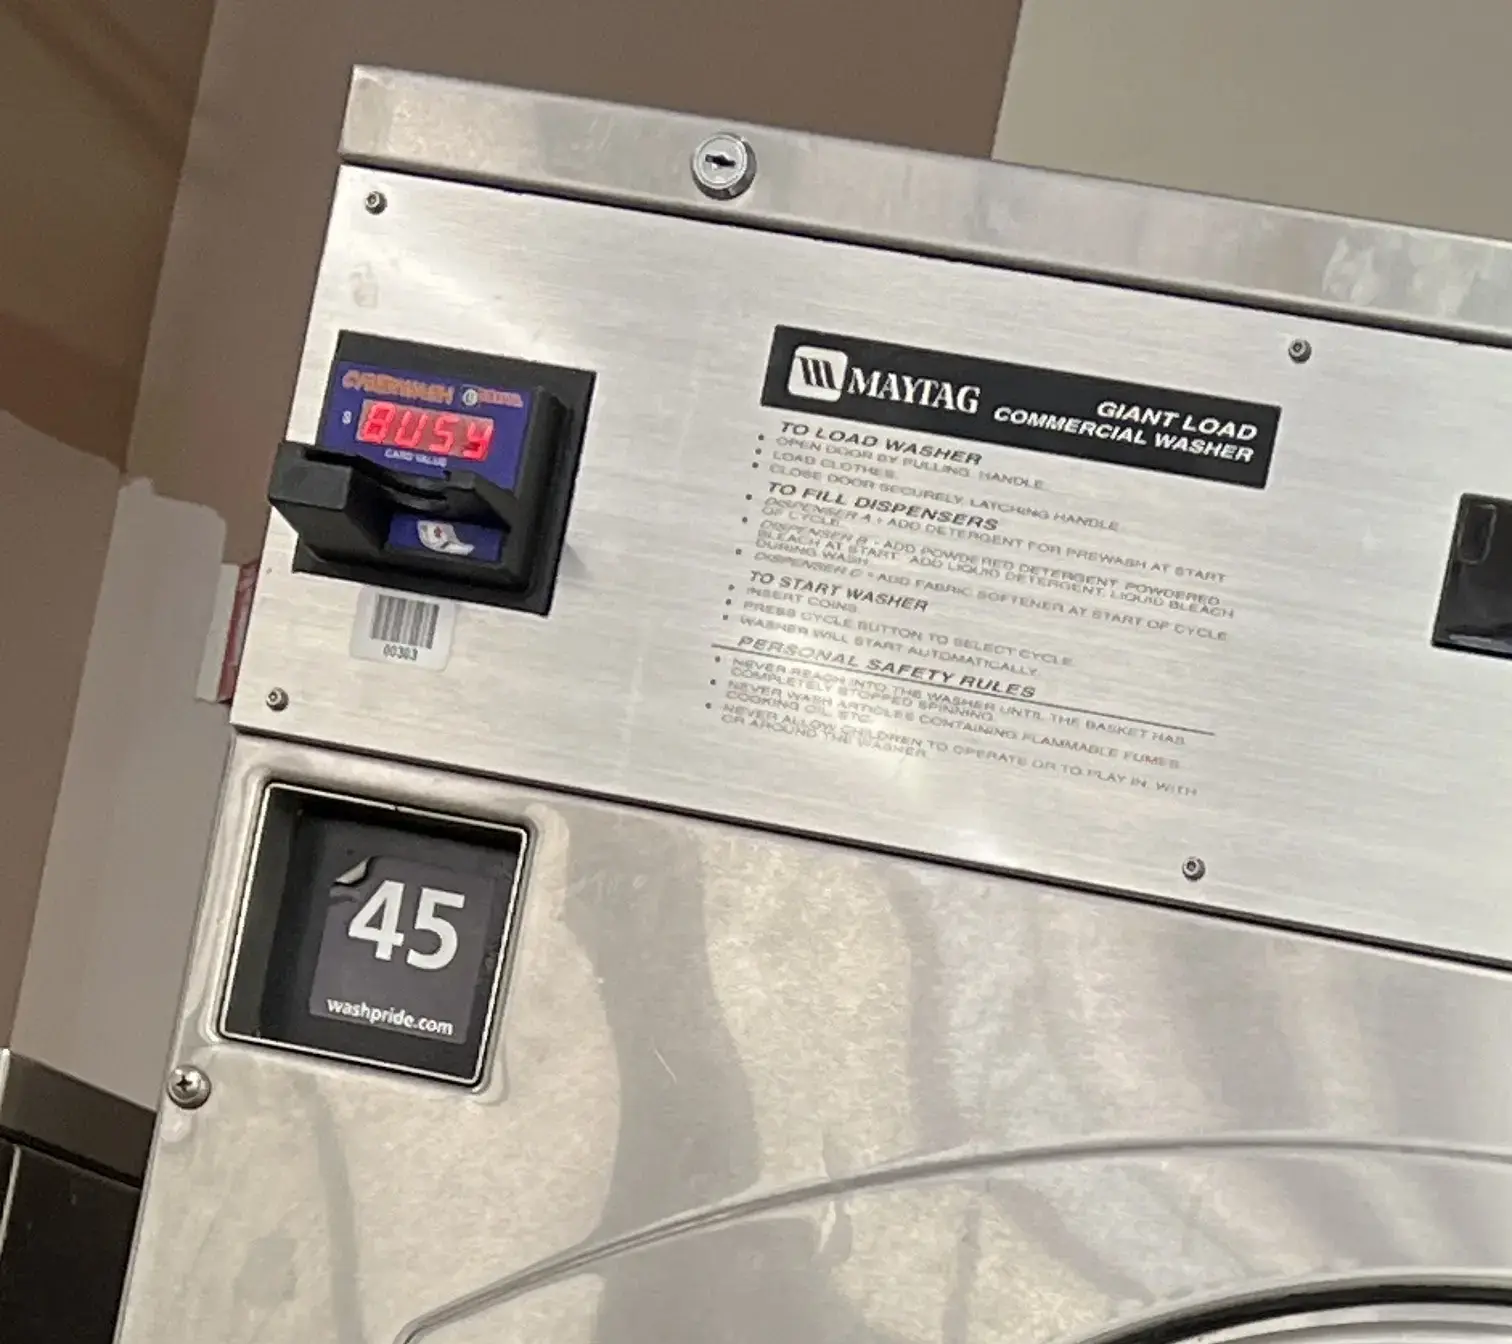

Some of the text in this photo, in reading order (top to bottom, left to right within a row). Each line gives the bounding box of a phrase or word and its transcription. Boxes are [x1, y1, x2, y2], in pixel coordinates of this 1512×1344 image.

[847, 366, 981, 415] MAYTAG
[994, 406, 1254, 465] COMMERCIAL WASHER
[1097, 401, 1258, 441] GIANT LOAD
[415, 451, 447, 467] VALUE
[772, 450, 816, 466] LOAD
[775, 435, 821, 450] OPEN
[825, 443, 873, 460] DOOR
[780, 420, 982, 467] TO LOAD WASHER
[768, 463, 821, 480] CLOSE
[826, 473, 874, 490] DOOR
[768, 481, 998, 531] TO FILL DISPENSERS
[882, 540, 916, 554] ADD
[886, 517, 921, 531] ADD
[924, 524, 1023, 549] DETERGENT
[1027, 541, 1060, 555] FOR
[1150, 563, 1170, 574] AT
[1174, 567, 1226, 584] START
[750, 569, 928, 612] TO START WASHER
[876, 572, 1170, 631] ADD FABRIC SOFTENER AT START OF
[1168, 600, 1234, 619] BLEACH
[740, 616, 808, 637] WASHER
[853, 636, 902, 654] START
[742, 600, 1017, 657] PRESS CYCLE BUTTON TO SELECT
[736, 634, 1036, 698] PERSONAL SAFETY RULES
[952, 744, 1028, 766] OPERATE
[1030, 757, 1056, 771] OR
[1060, 762, 1080, 775] TO
[1086, 767, 1126, 783] PLAY
[349, 879, 465, 970] 45
[326, 998, 453, 1036] washpride.com
